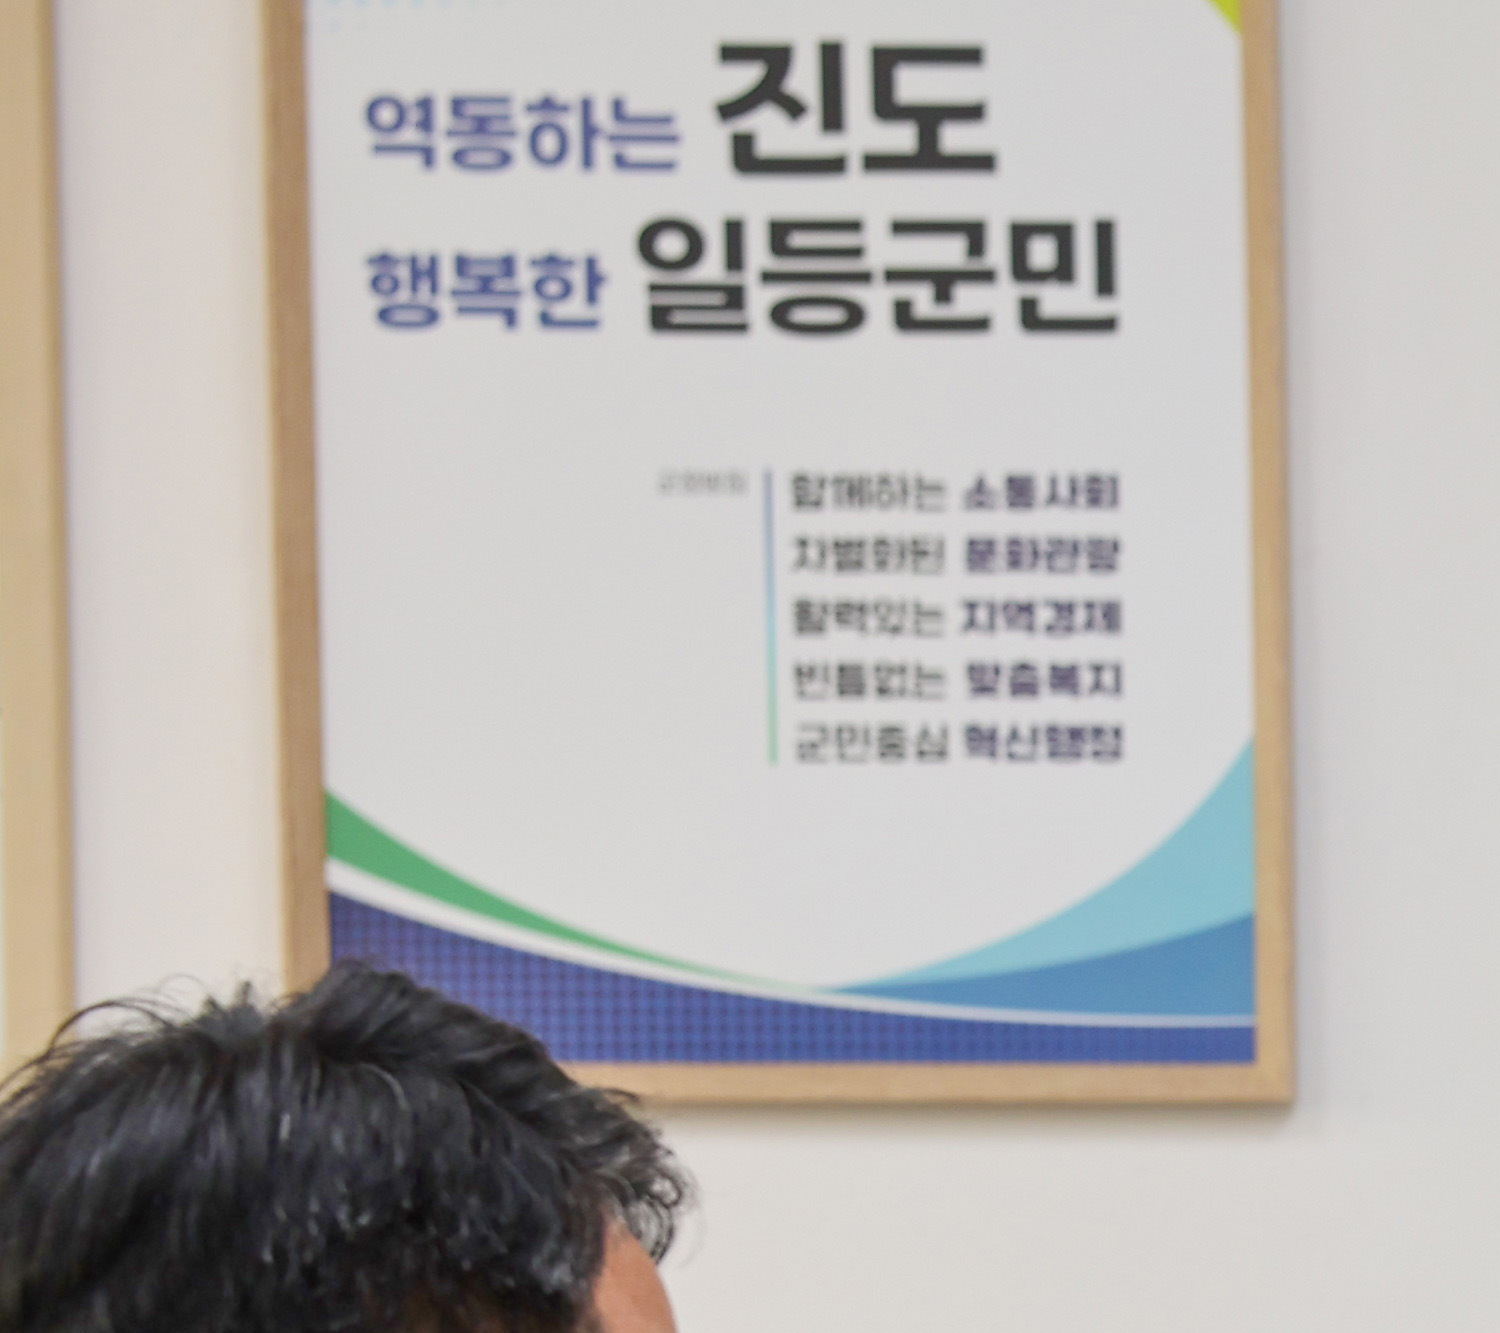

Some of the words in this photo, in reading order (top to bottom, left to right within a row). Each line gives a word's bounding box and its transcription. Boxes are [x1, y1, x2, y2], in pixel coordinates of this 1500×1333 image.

[364, 94, 681, 173] 역동하는
[714, 40, 998, 178] 진도
[366, 250, 607, 331] 행복한
[636, 216, 1119, 338] 일등군민
[790, 472, 946, 512] 함께하는
[964, 473, 1120, 511] 소통사회
[793, 536, 945, 574] 차별화된
[964, 535, 1121, 575] 문화관광
[792, 597, 944, 637] 활력있는
[962, 599, 1122, 637] 지역경제
[793, 661, 945, 700] 빈틈없는
[966, 660, 1122, 699] 맞춤복지
[796, 723, 949, 763] 군민중심
[963, 723, 1123, 763] 혁신행정
